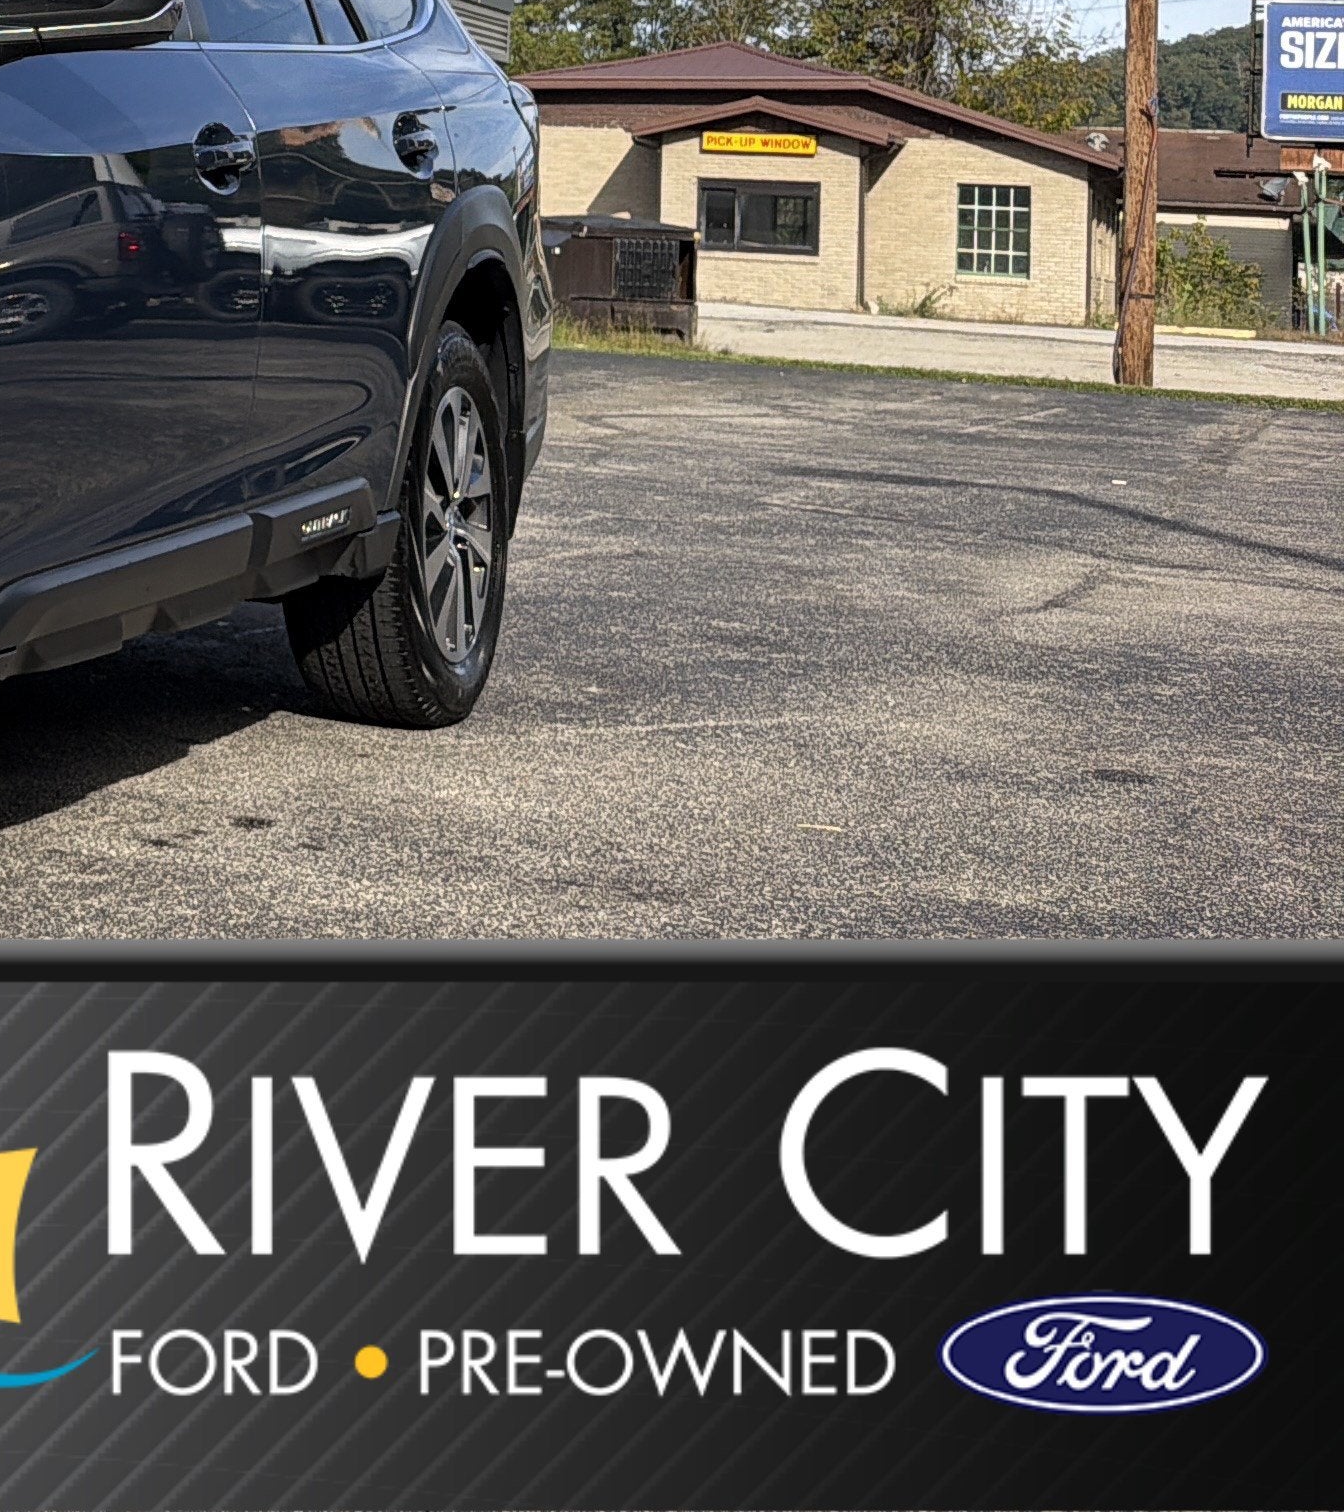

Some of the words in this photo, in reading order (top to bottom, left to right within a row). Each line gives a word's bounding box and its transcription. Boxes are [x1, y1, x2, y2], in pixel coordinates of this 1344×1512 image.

[1280, 30, 1344, 68] SIZ
[1287, 94, 1343, 110] MORGAN
[706, 134, 756, 148] PICK-UP
[760, 138, 812, 150] WINDOW
